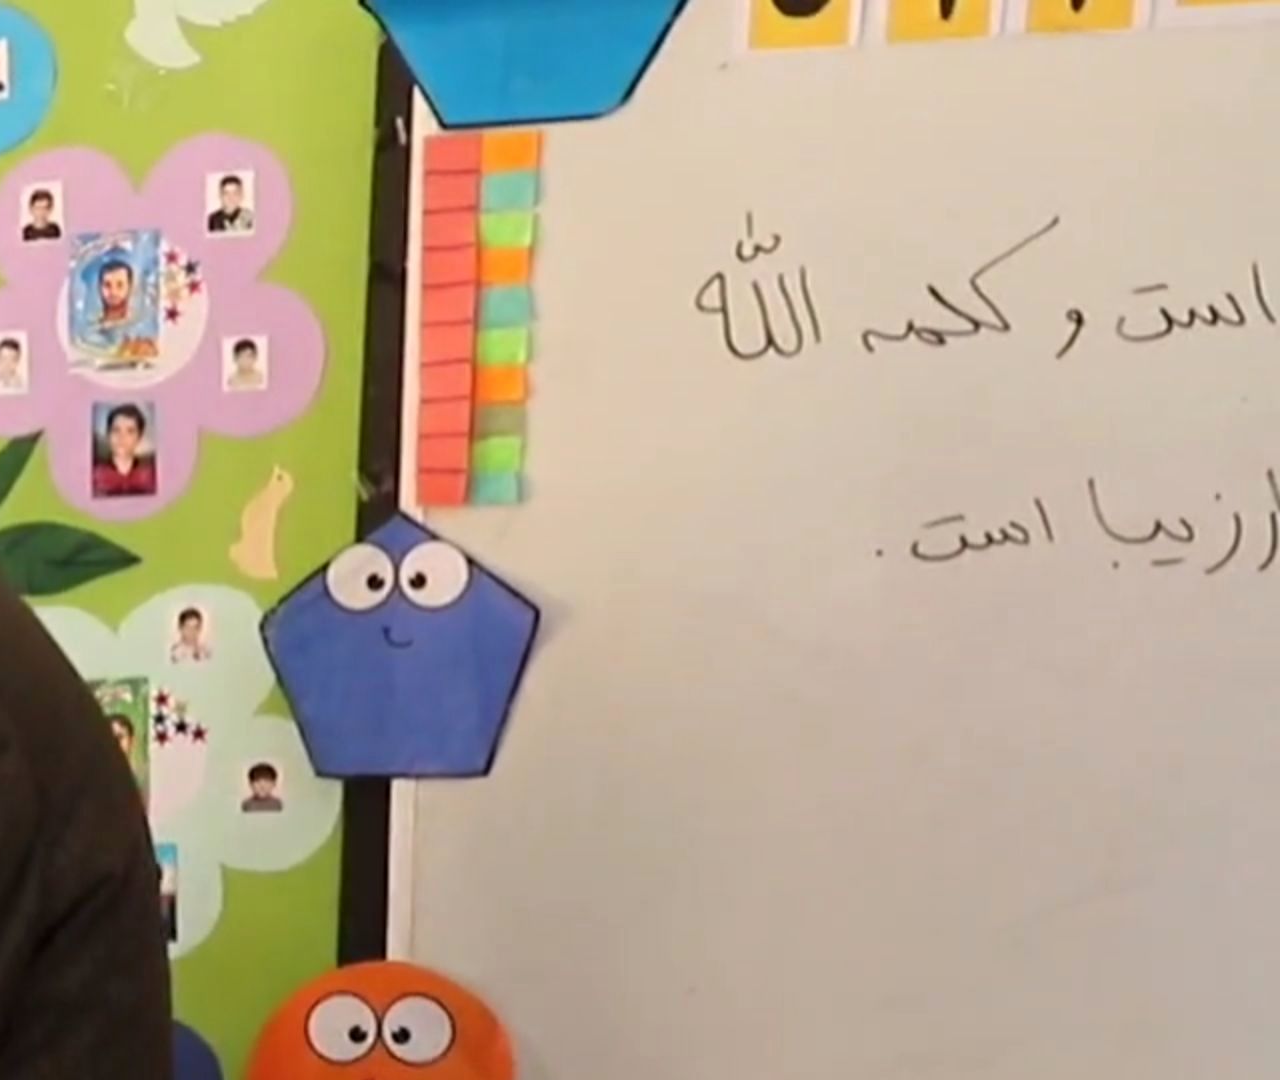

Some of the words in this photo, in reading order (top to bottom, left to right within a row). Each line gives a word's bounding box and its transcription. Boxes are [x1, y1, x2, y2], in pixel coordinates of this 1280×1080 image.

[1055, 307, 1086, 360] و
[1115, 261, 1277, 343] است
[1087, 477, 1243, 576] زیبا
